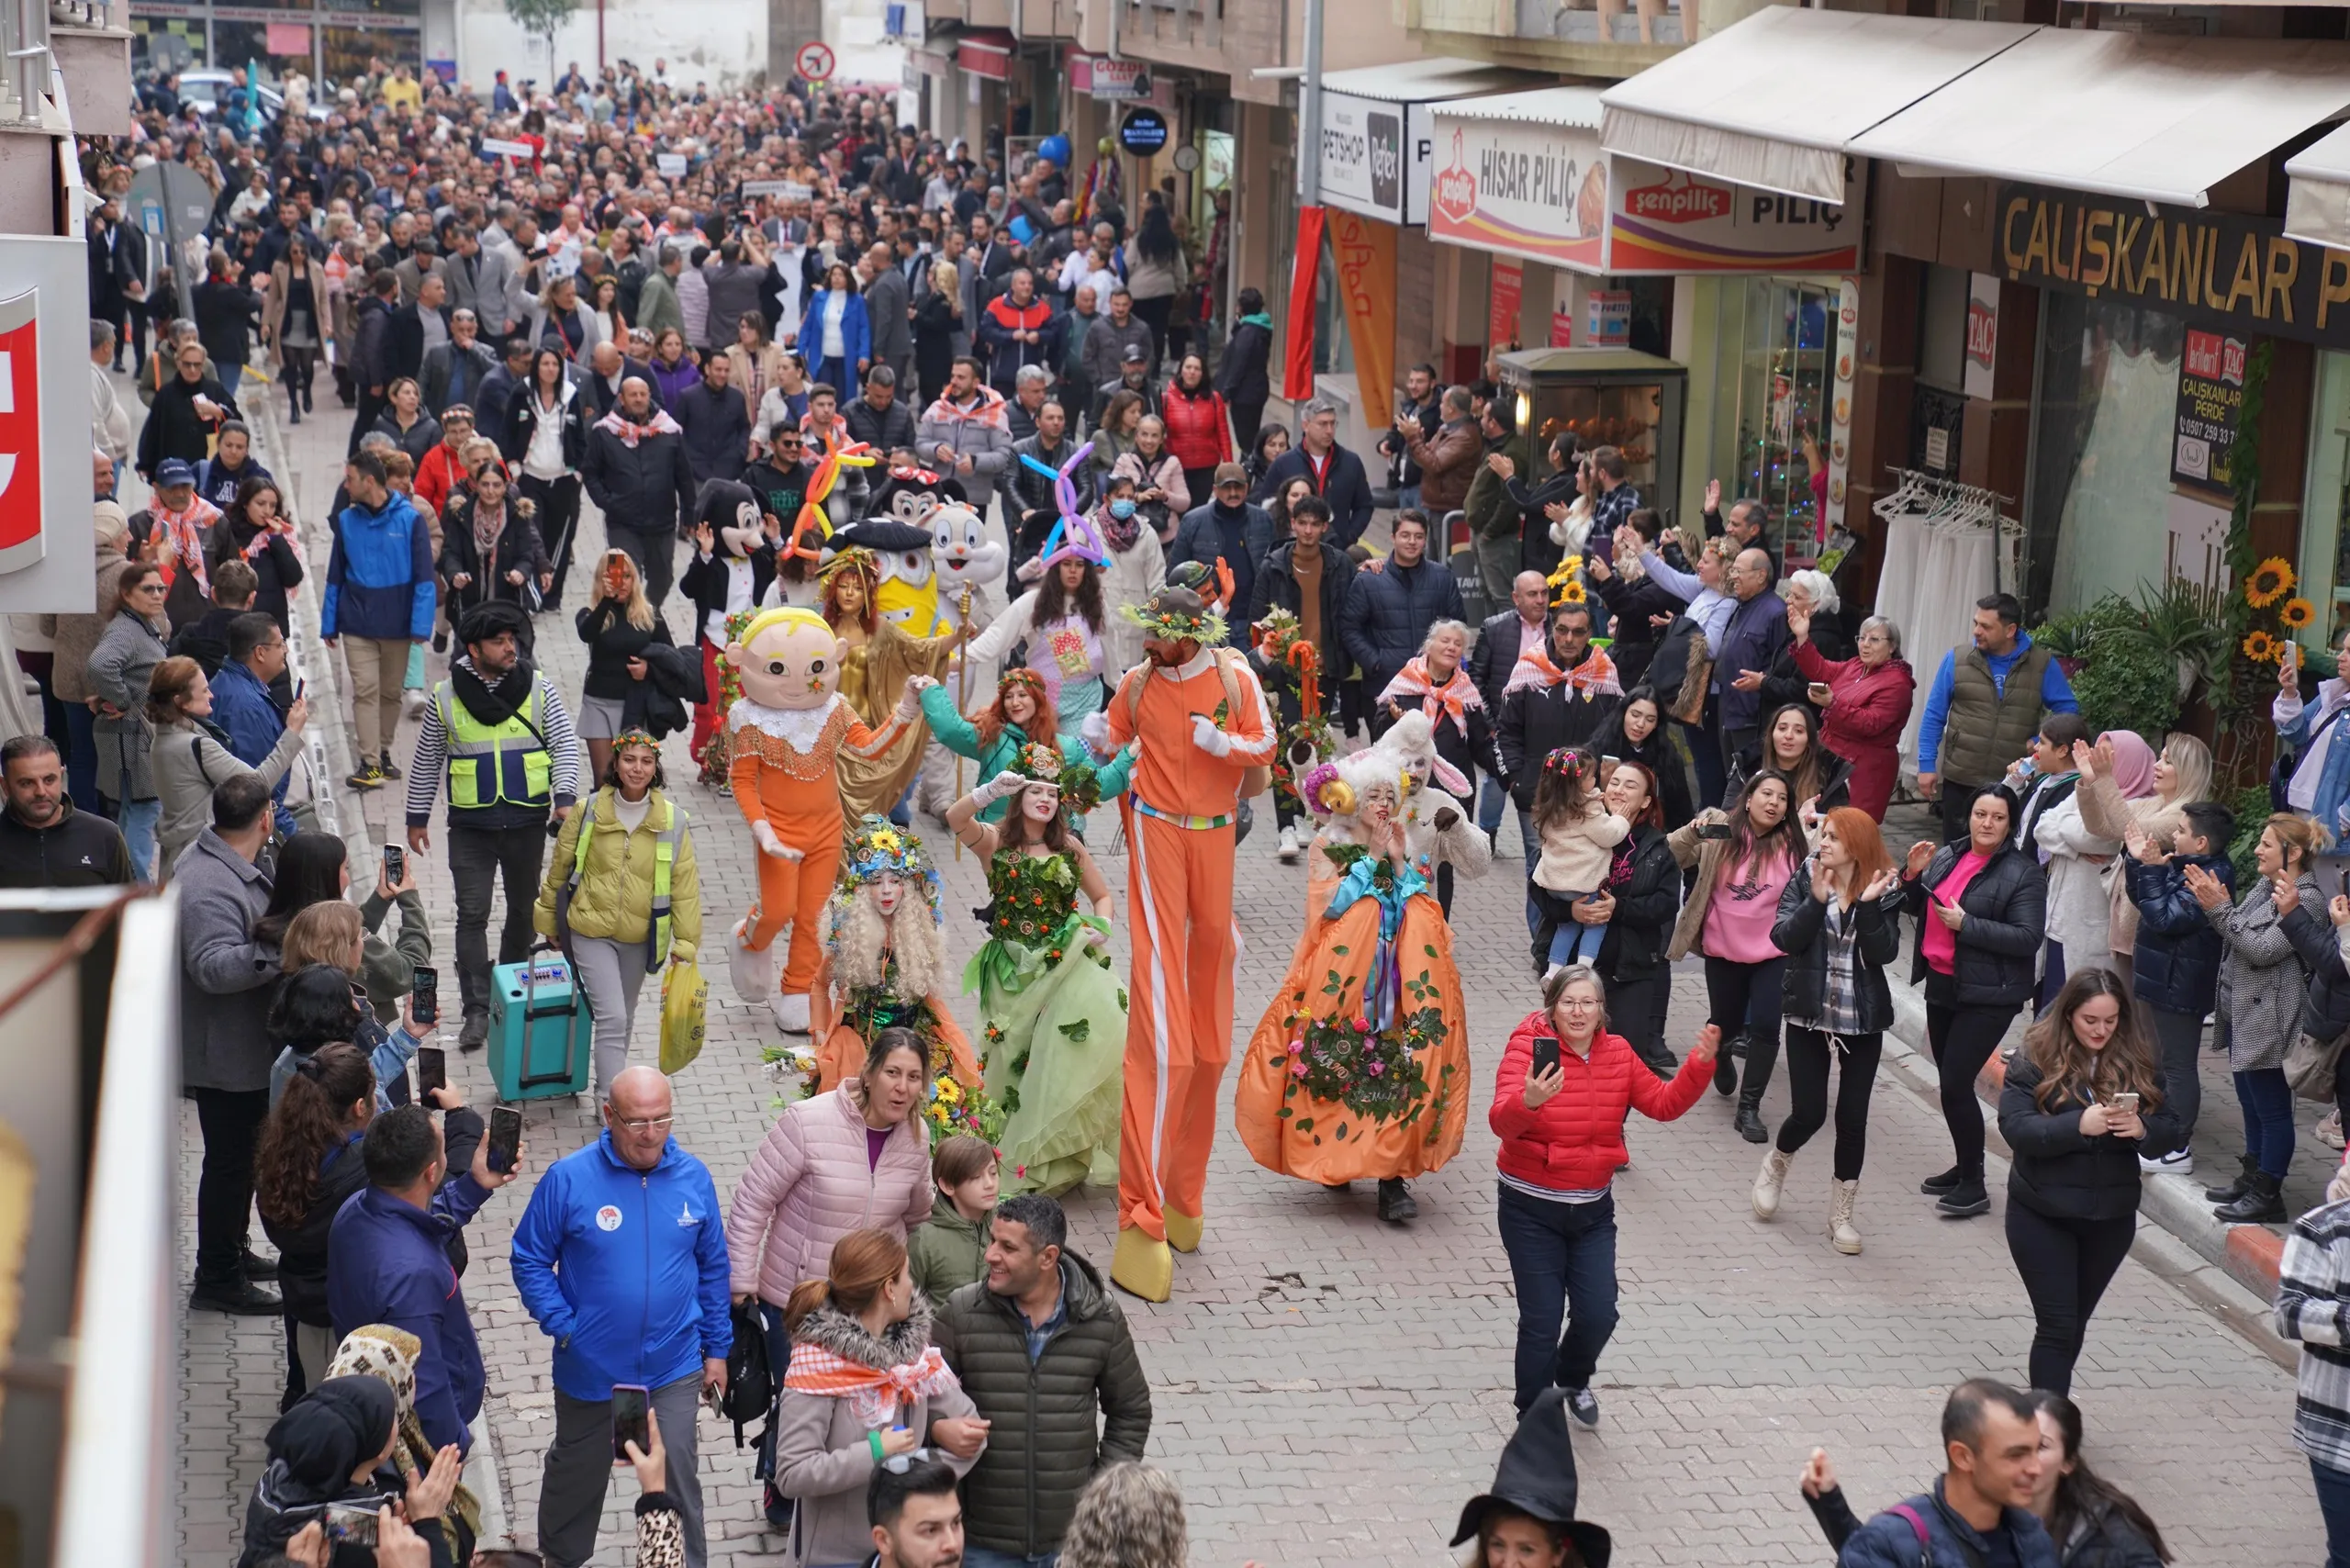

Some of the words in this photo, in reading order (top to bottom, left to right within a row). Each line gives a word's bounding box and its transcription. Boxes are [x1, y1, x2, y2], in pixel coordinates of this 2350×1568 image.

[1323, 128, 1364, 166] PETSHOP
[1371, 133, 1397, 186] Reflex
[1481, 138, 1528, 202] HİSAR
[1533, 143, 1577, 224] PİLİÇ
[1635, 187, 1719, 216] şenpiliç
[2003, 196, 2300, 324] ÇALIŞKANLAR
[1968, 312, 1994, 363] TAÇ
[2224, 348, 2244, 379] TAÇ
[2182, 378, 2242, 407] ÇALIŞKANLAR
[2195, 399, 2225, 421] PERDE
[2186, 418, 2204, 437] 0507
[2204, 423, 2218, 442] 259
[2219, 428, 2229, 444] 33
